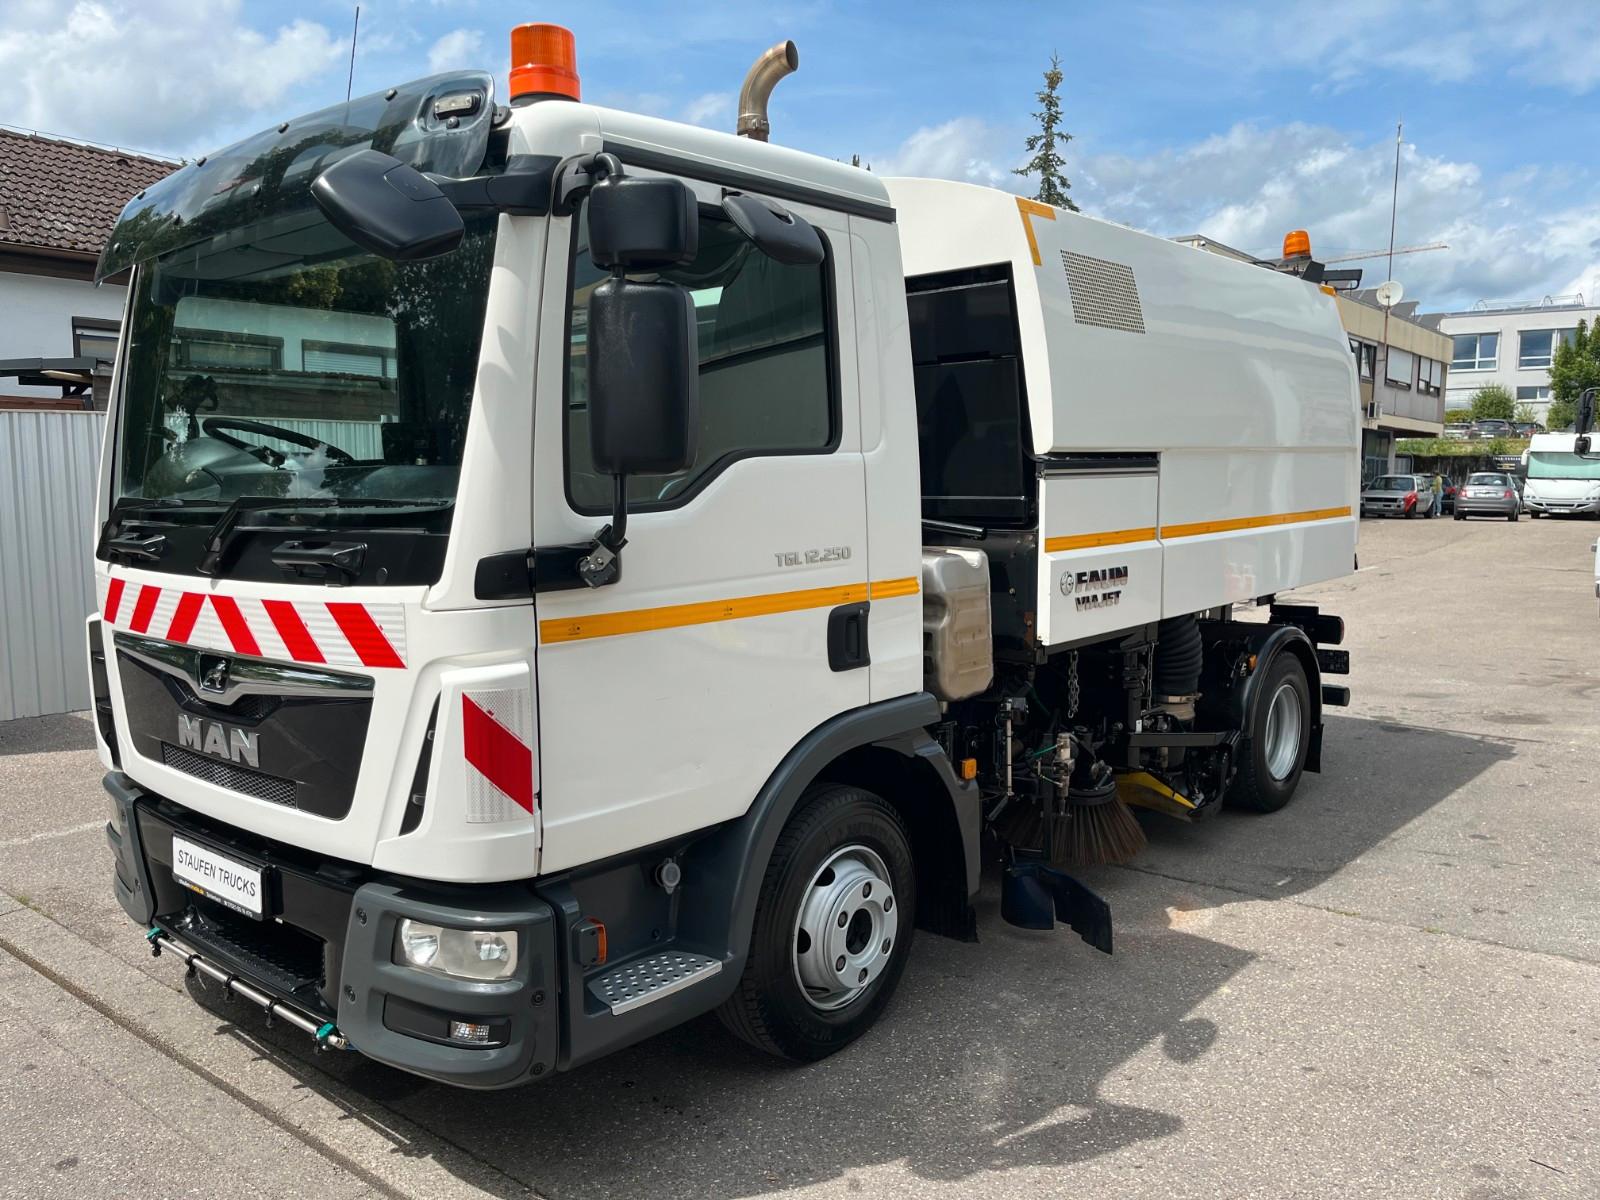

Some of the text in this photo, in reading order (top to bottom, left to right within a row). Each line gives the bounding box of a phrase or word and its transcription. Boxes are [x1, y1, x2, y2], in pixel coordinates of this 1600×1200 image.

[774, 545, 852, 567] TGL 12.250
[1075, 565, 1128, 593] FAUN
[1075, 590, 1122, 612] VIAJET
[178, 713, 260, 768] MAN
[177, 849, 217, 880] STAUFEN
[218, 867, 256, 897] TRUCKS
